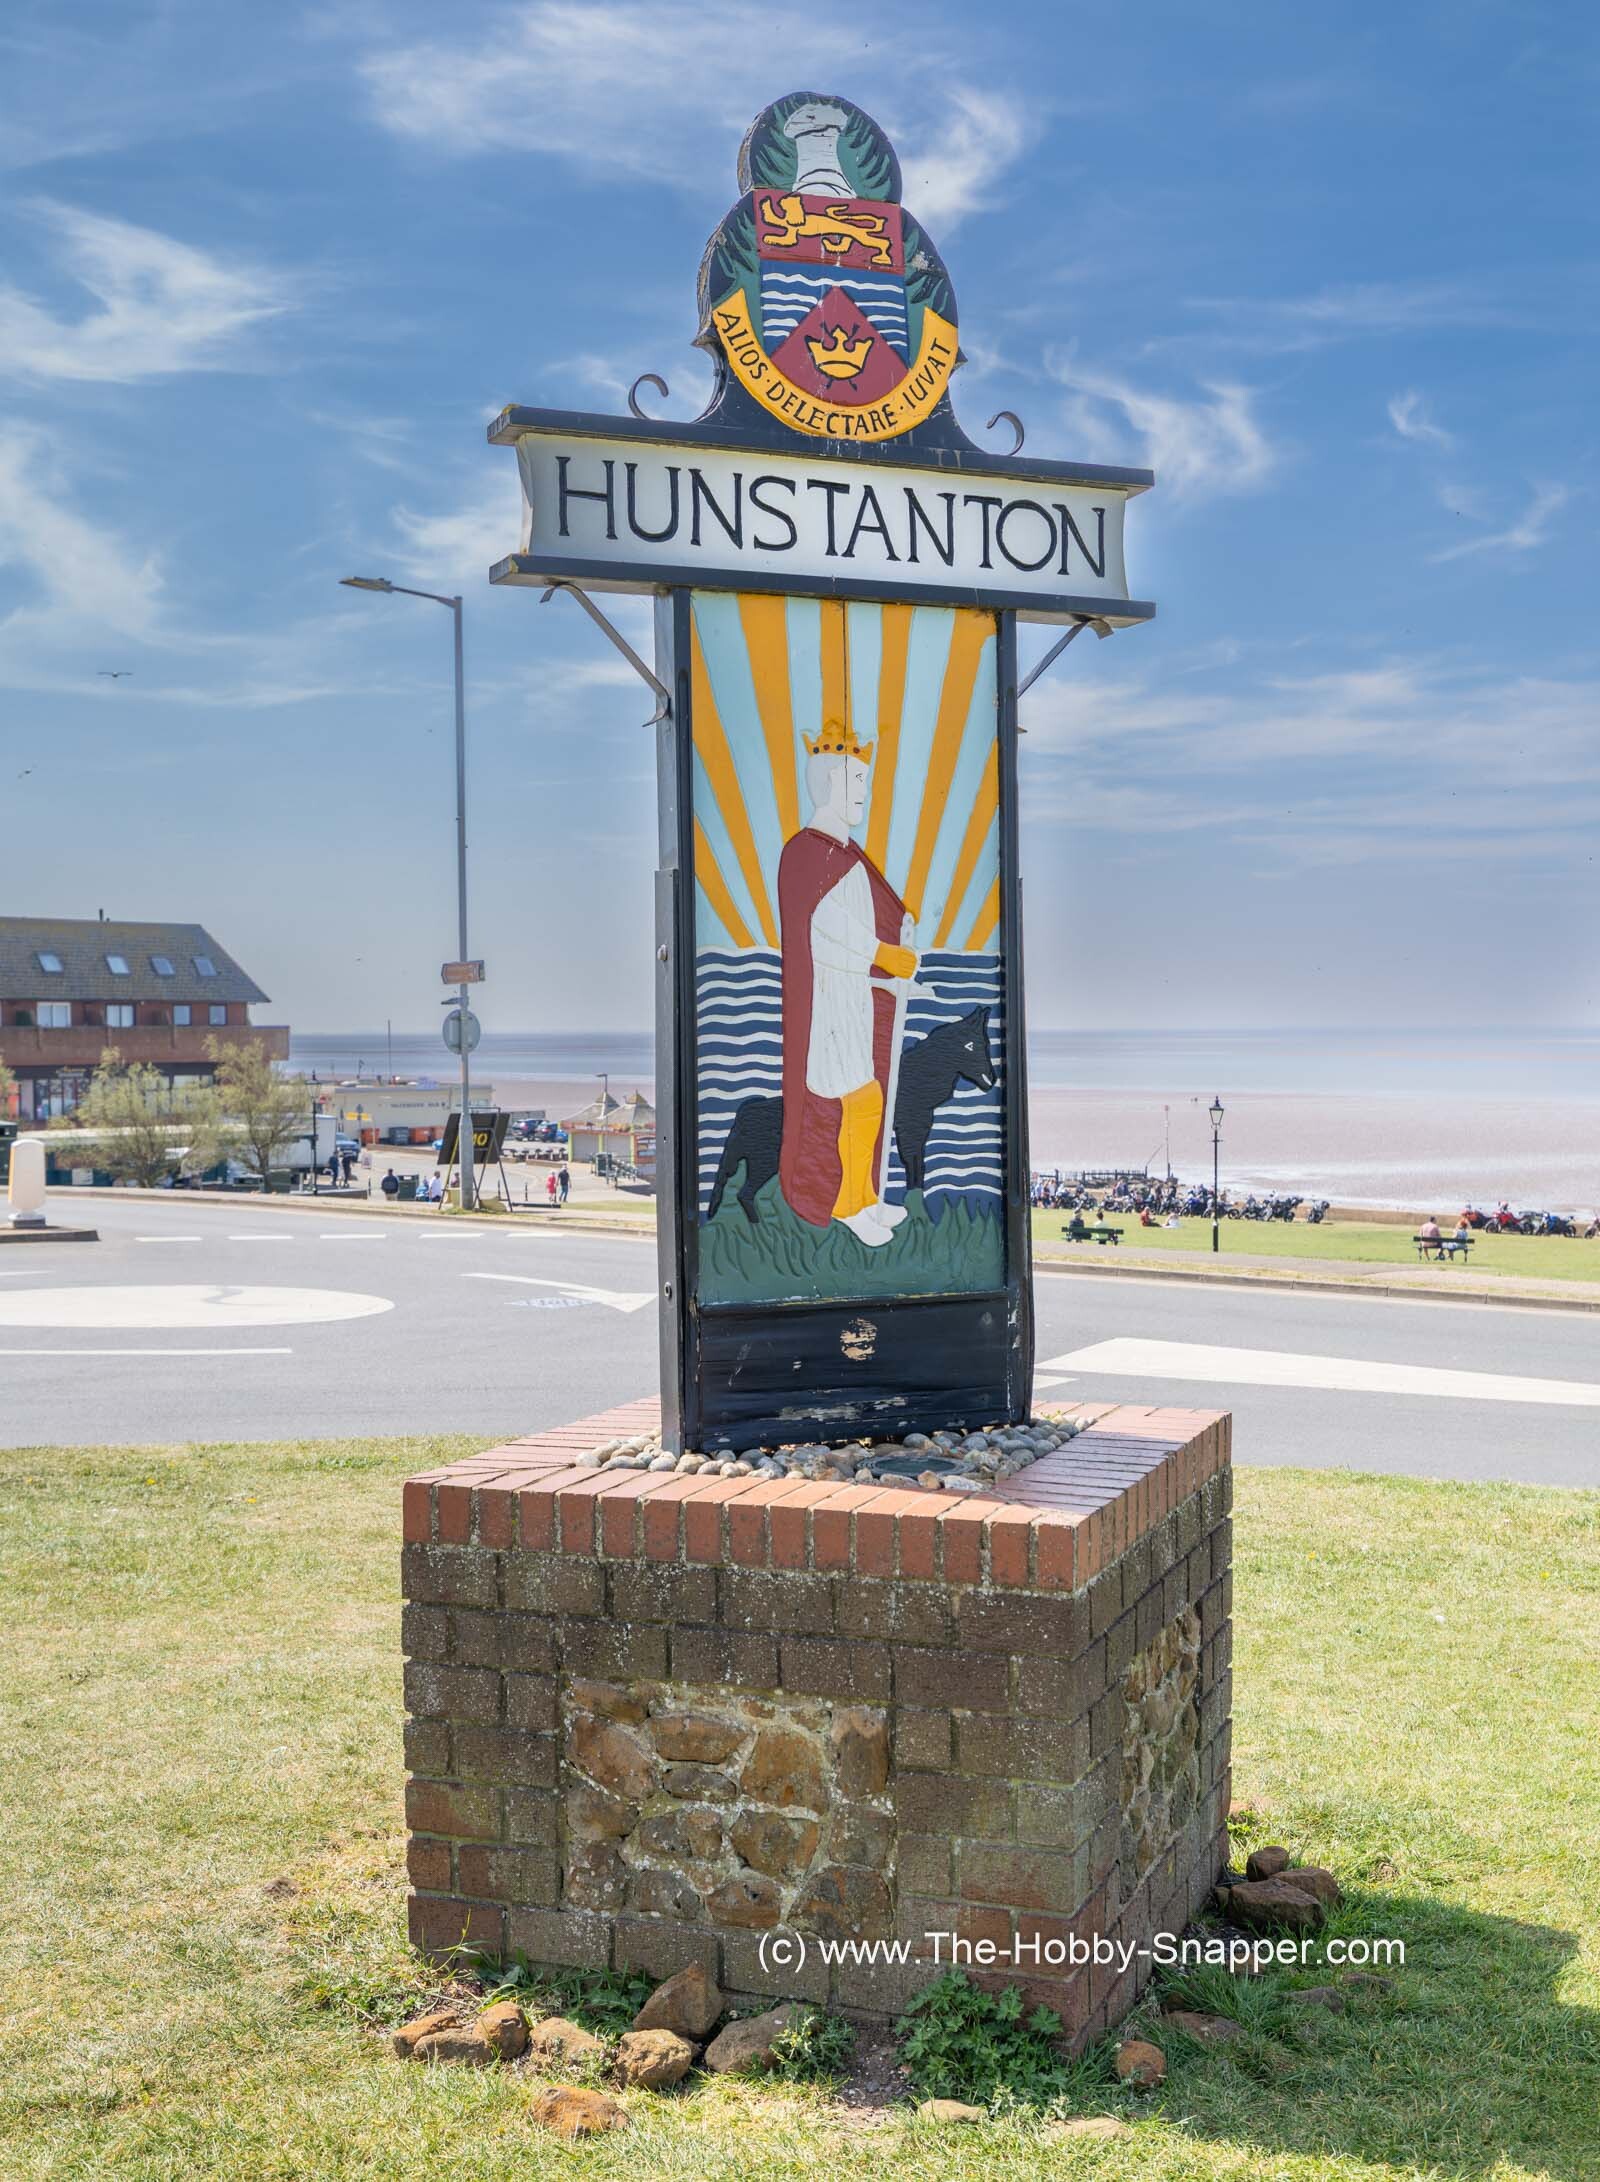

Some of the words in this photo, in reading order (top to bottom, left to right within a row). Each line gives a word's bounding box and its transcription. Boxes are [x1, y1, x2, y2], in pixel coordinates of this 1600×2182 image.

[717, 310, 769, 379] ALIOS
[765, 380, 898, 436] DELECTARE
[902, 337, 951, 410] IUVAT
[554, 455, 1106, 578] HUNSTANTON
